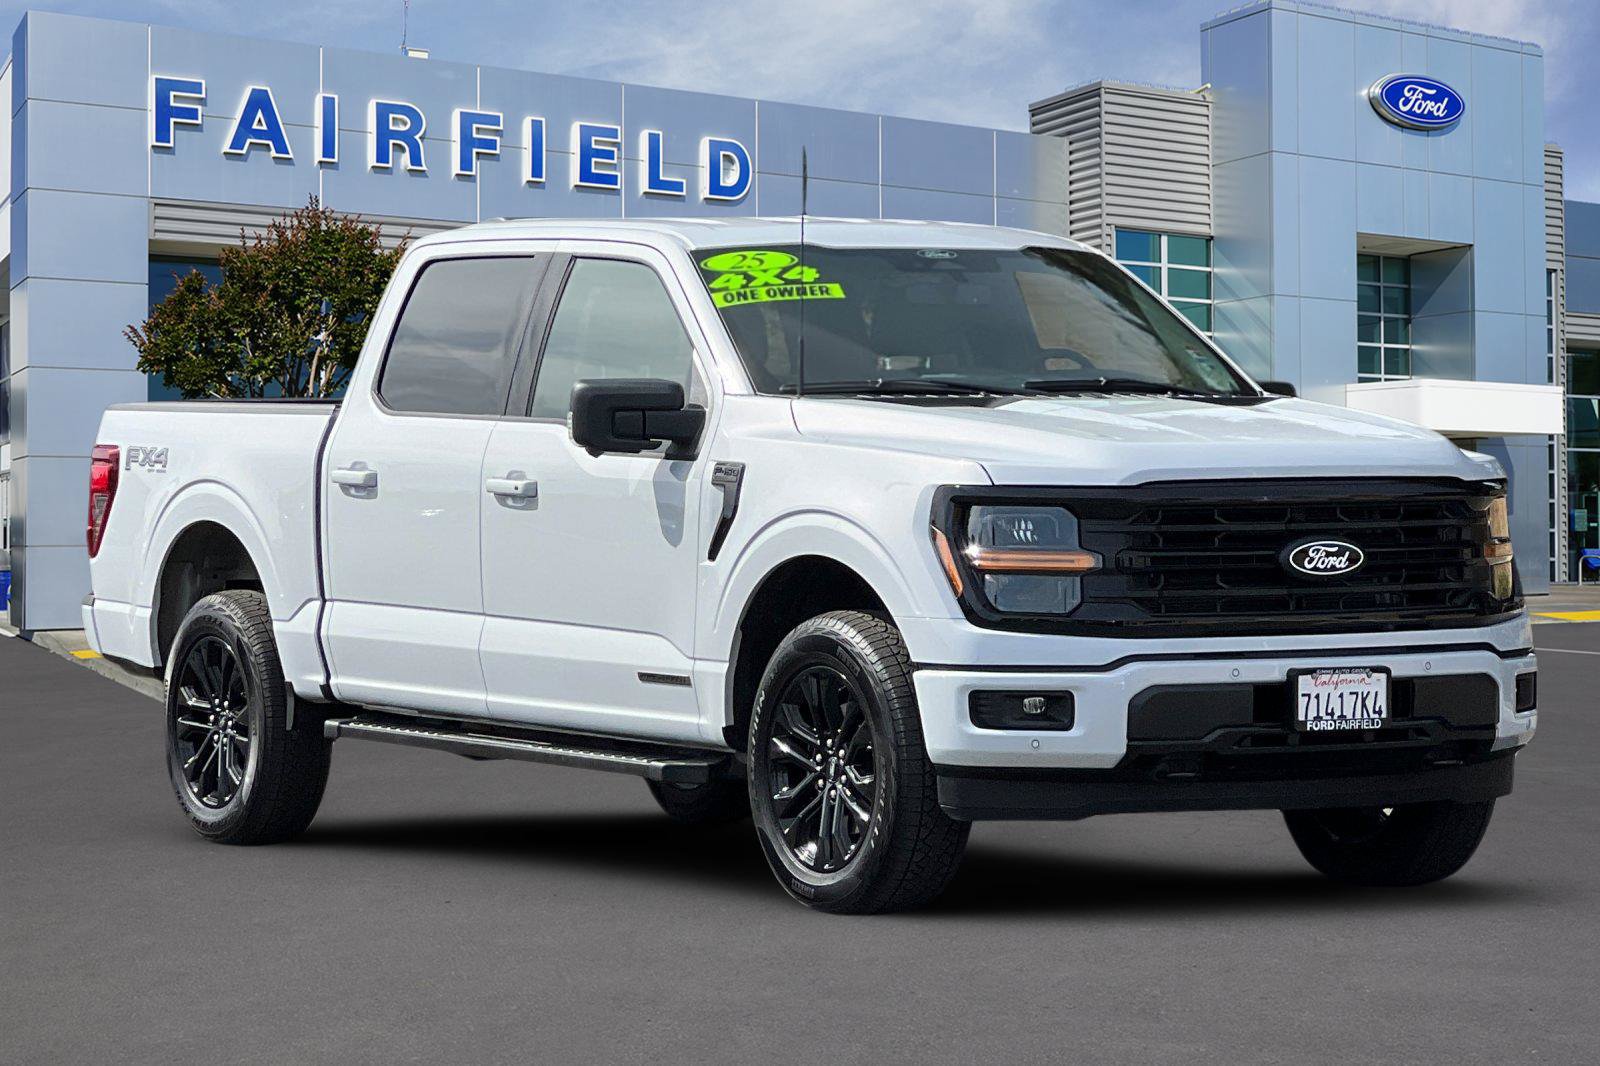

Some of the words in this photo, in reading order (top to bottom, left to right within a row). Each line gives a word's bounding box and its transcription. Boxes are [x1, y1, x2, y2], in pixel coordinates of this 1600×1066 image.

[1399, 85, 1448, 117] Ford
[150, 75, 753, 201] FAIRFIELD
[729, 253, 766, 269] 25
[722, 288, 759, 304] ONE
[765, 285, 831, 299] OWNER
[125, 445, 169, 470] FX4
[1304, 545, 1350, 569] Ford
[1314, 673, 1371, 691] California
[1301, 691, 1383, 720] 71417K4
[1306, 721, 1335, 731] FORD
[1336, 719, 1382, 730] FAIRFIELD
